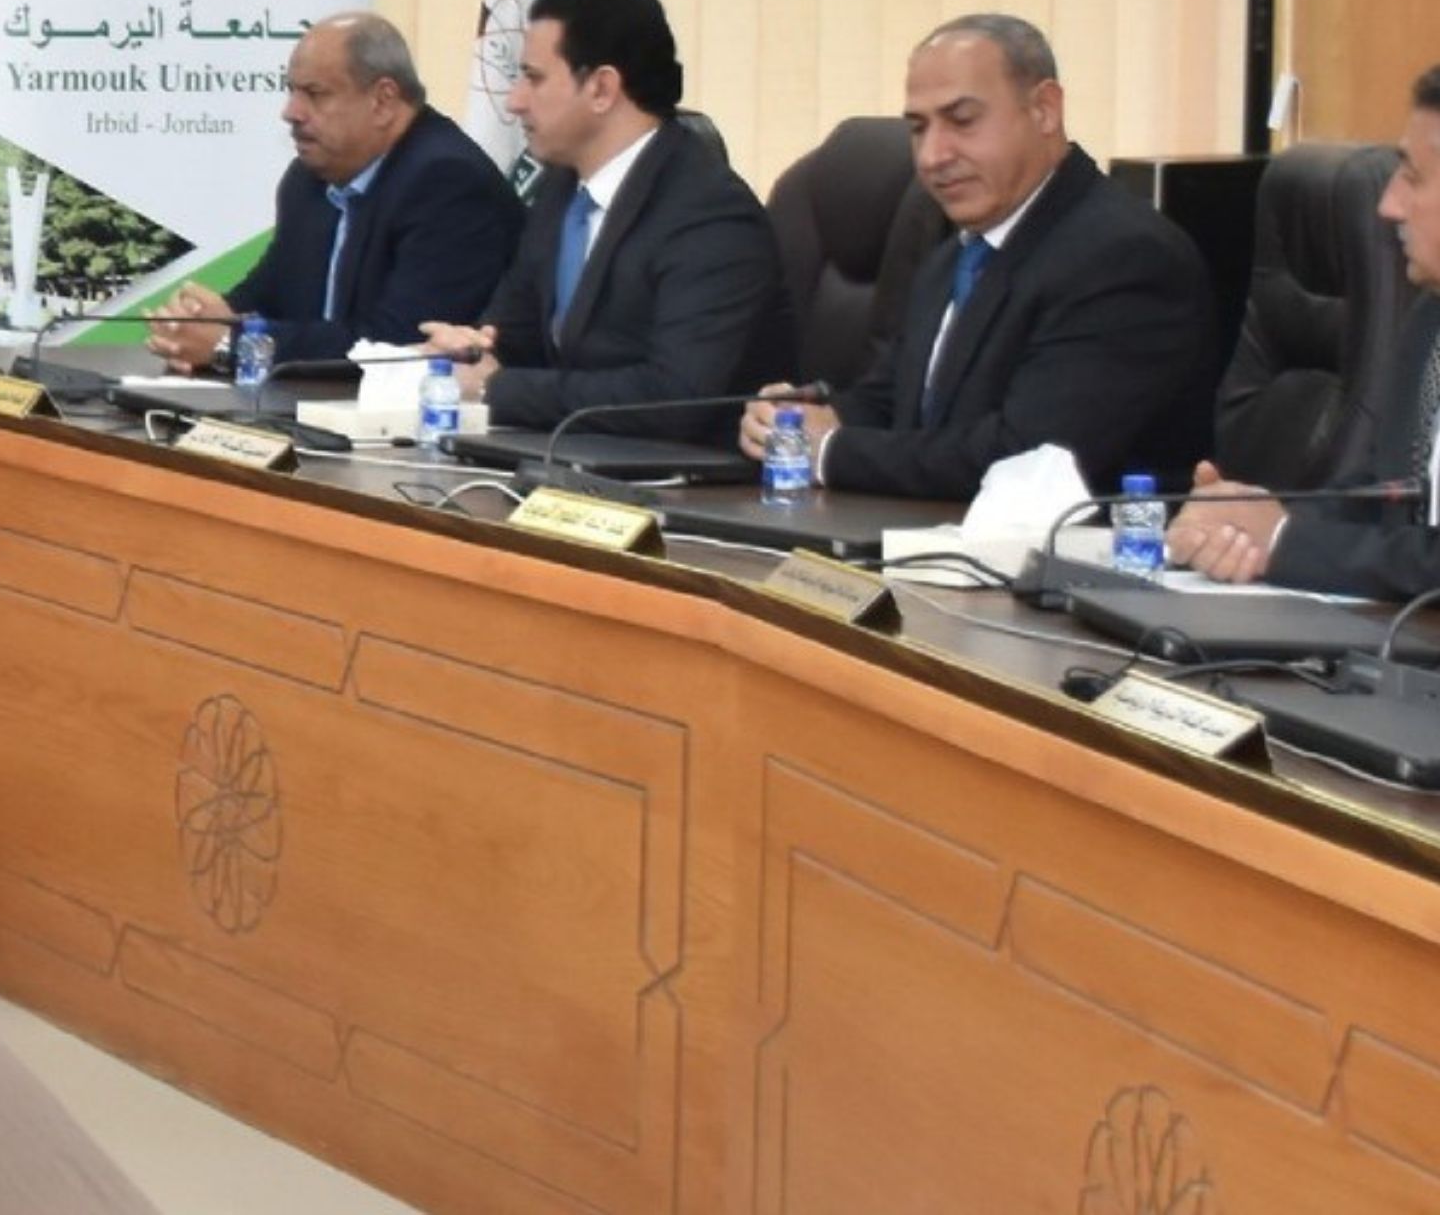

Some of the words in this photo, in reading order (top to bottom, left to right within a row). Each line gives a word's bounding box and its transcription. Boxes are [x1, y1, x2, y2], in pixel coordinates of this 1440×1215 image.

[4, 3, 164, 49] اليرموك
[7, 61, 147, 93] Yarmouk
[86, 112, 139, 134] Irbid
[160, 112, 234, 135] Jordan
